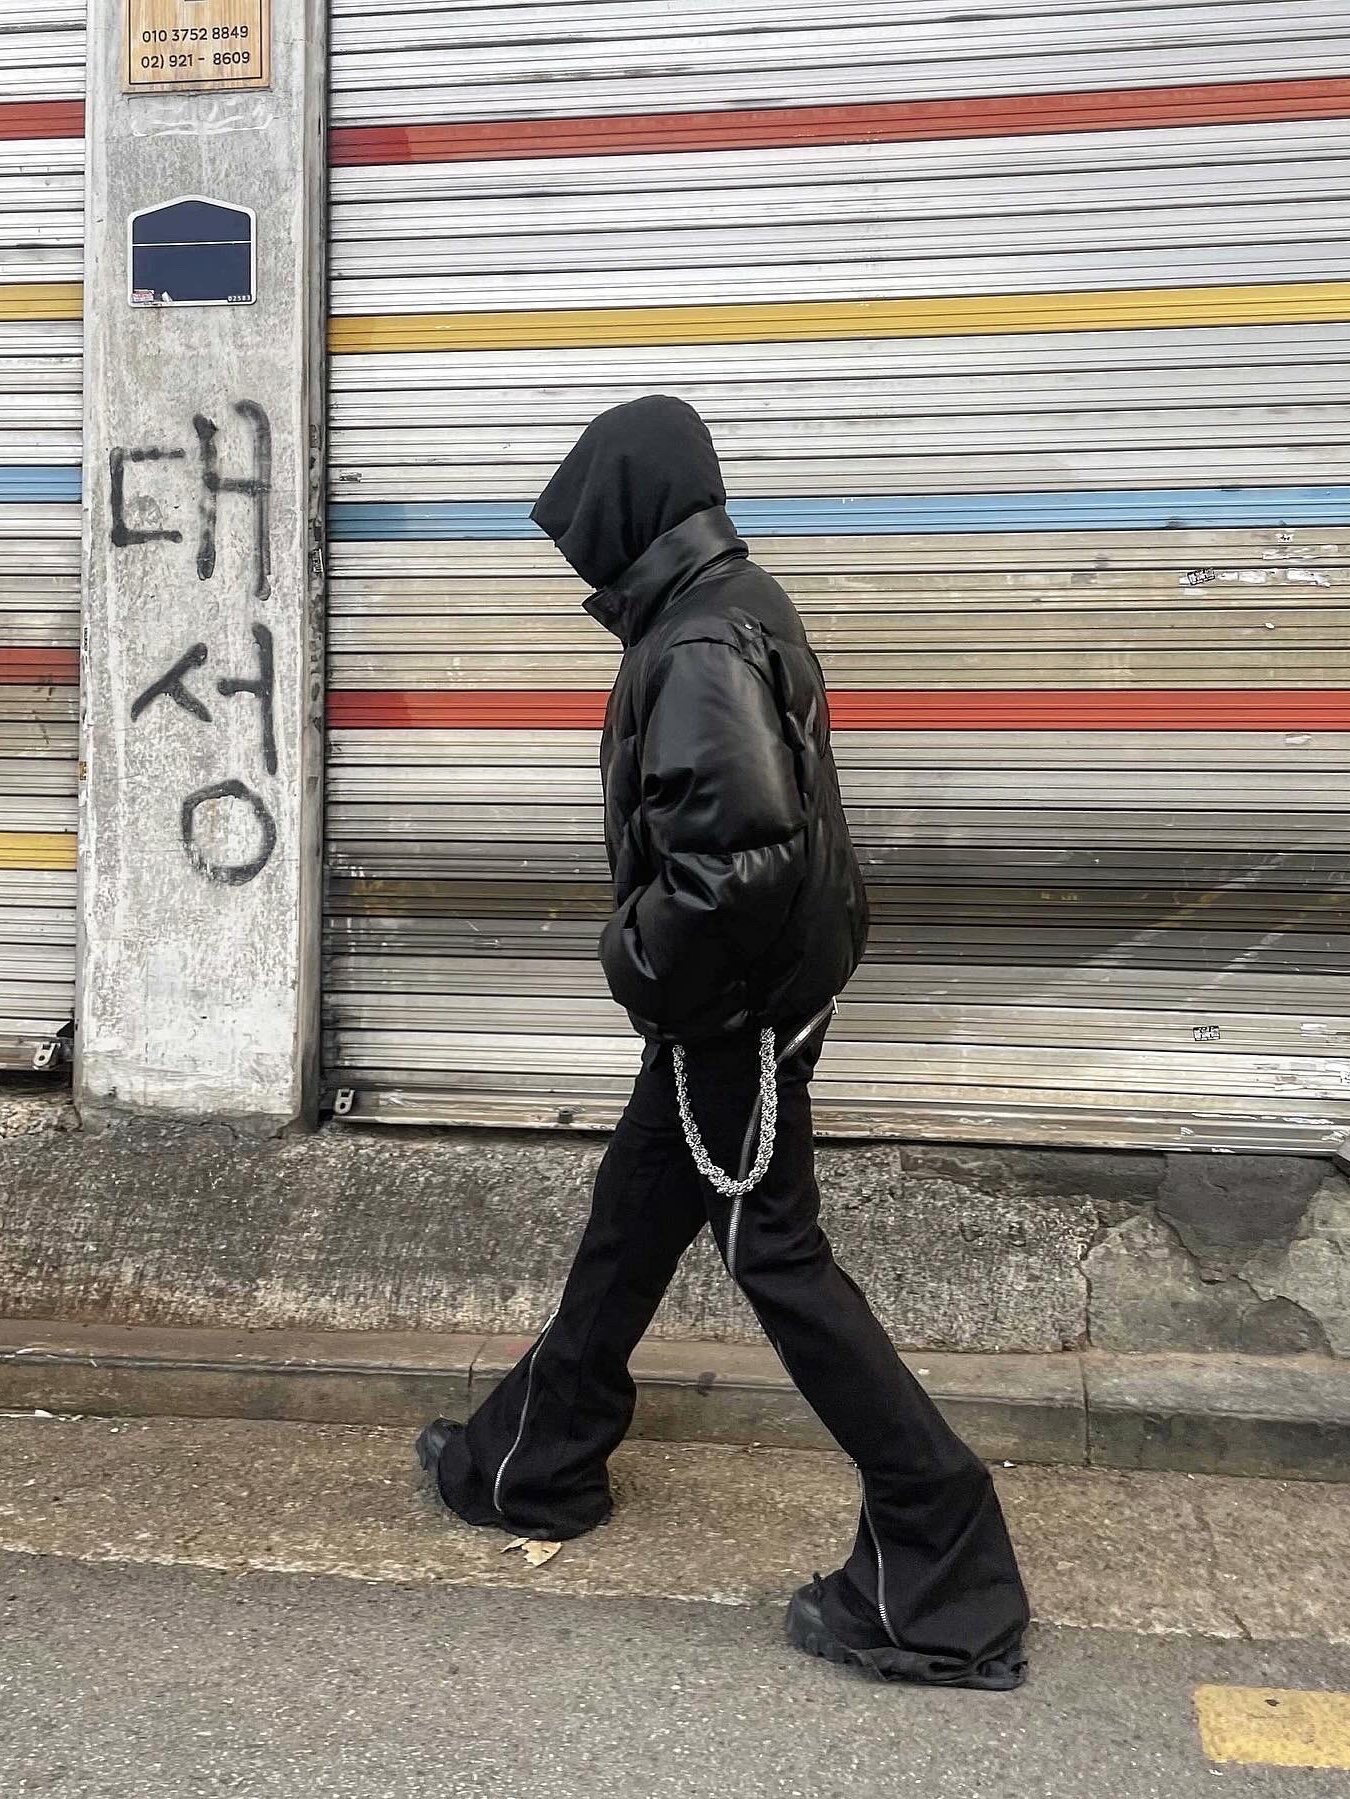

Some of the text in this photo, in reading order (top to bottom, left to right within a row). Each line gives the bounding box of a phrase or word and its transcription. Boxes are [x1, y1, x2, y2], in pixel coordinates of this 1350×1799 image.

[142, 25, 249, 43] 010 3752 8849
[141, 54, 165, 69] 02)
[169, 54, 193, 67] 921
[213, 51, 250, 65] 8609
